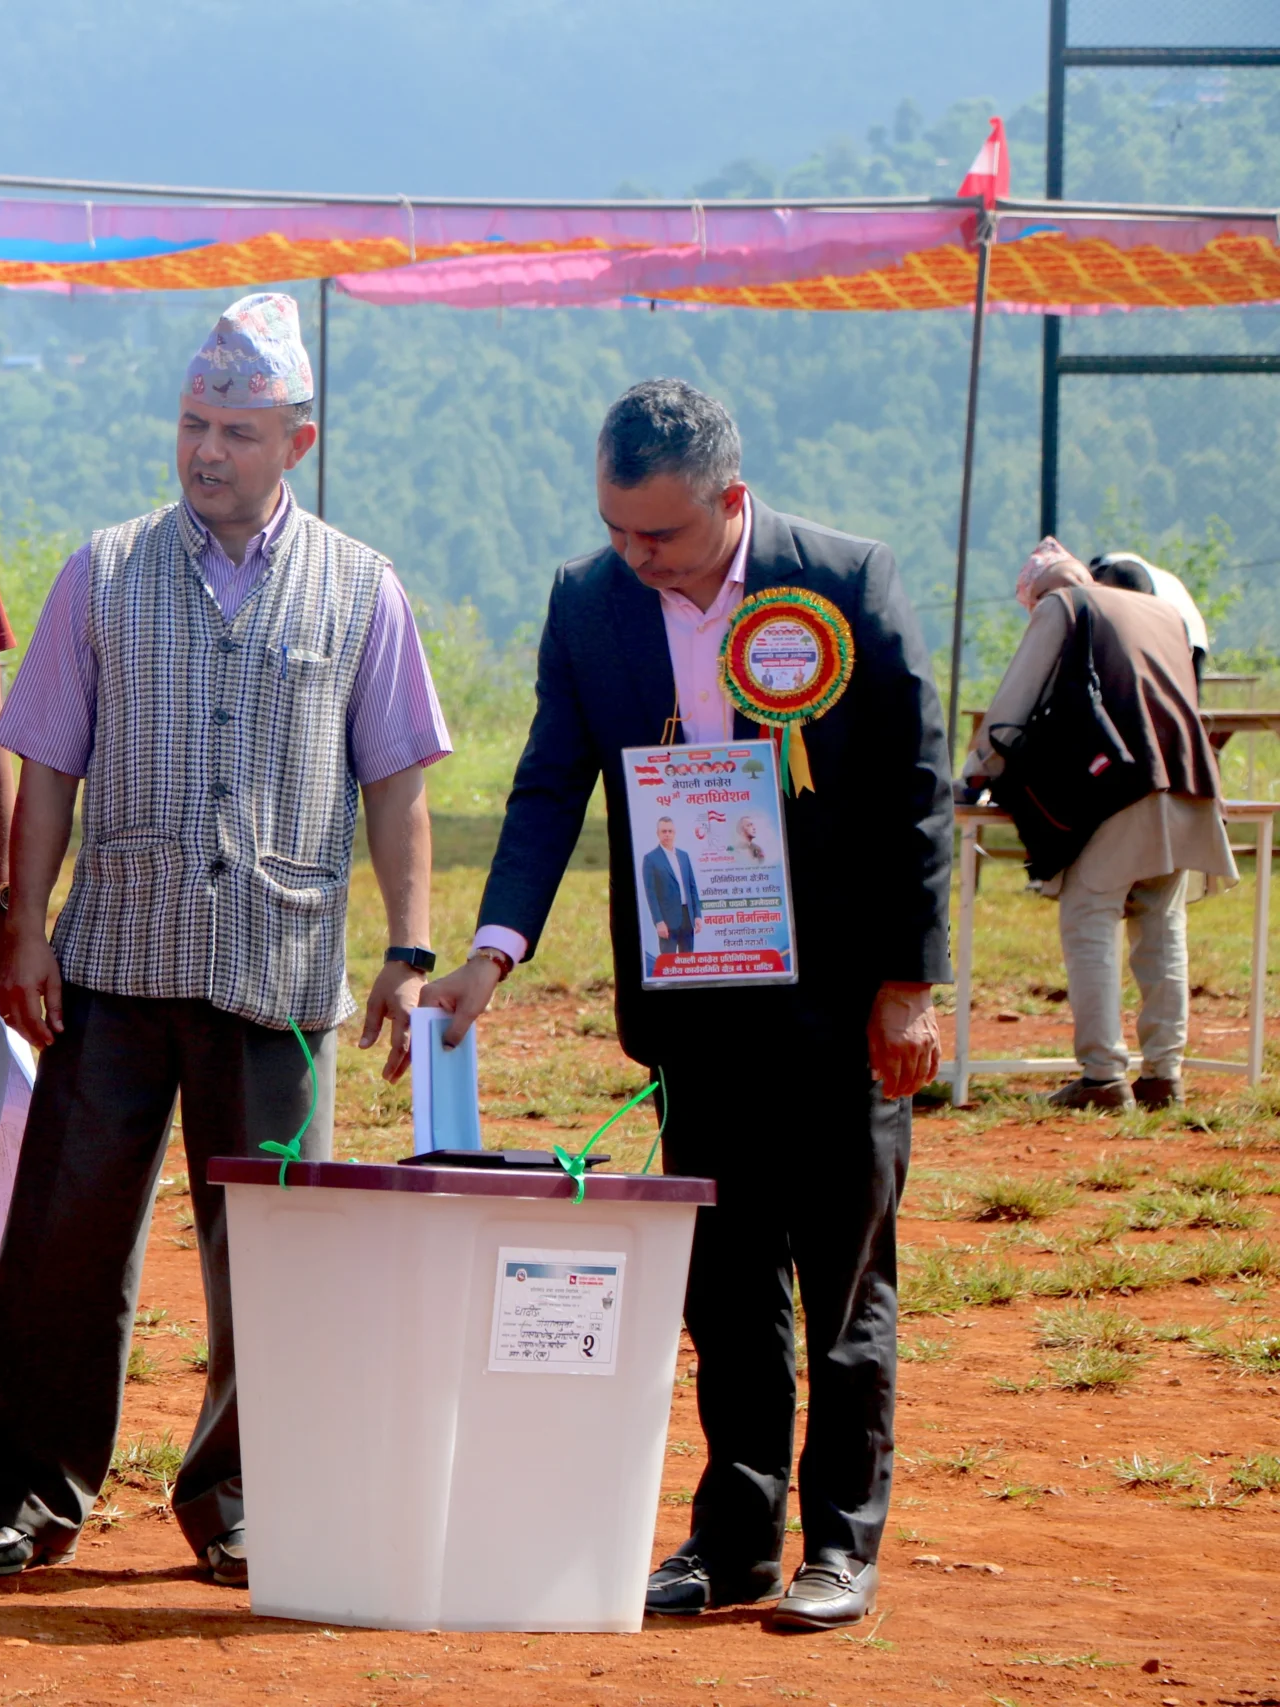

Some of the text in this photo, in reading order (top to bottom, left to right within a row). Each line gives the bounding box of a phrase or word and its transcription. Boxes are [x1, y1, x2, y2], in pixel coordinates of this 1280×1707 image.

[672, 776, 732, 788] नेपाली कांग्रेस
[686, 790, 750, 805] महाधिवेशन
[704, 914, 734, 925] नवराज
[582, 1335, 595, 1357] २
